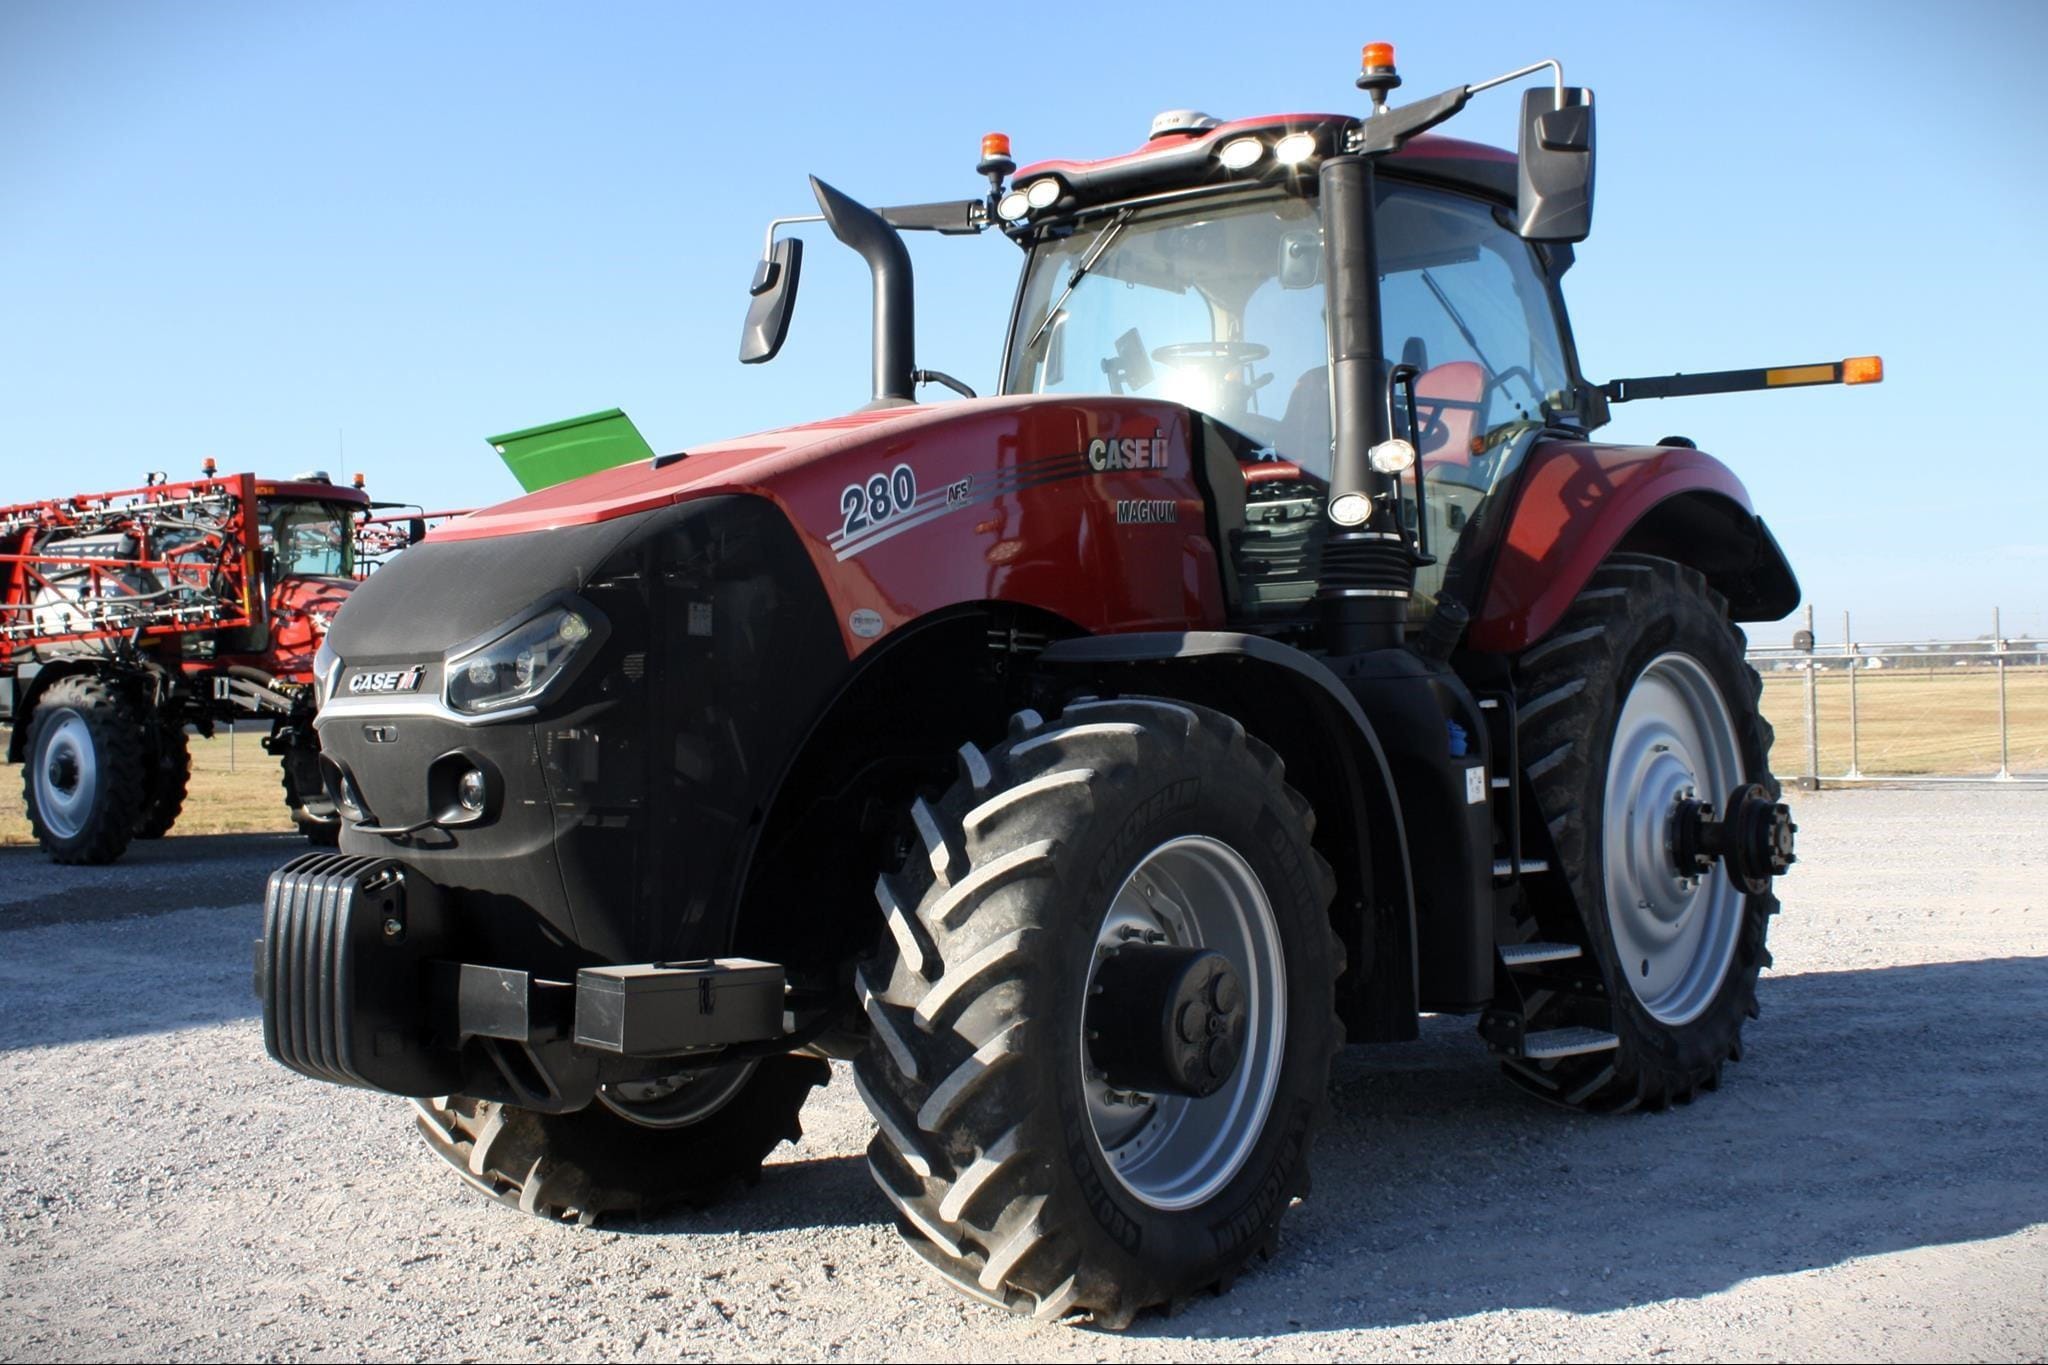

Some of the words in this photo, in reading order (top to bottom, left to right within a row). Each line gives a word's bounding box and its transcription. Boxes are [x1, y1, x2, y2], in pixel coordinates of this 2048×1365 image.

[840, 463, 917, 539] 280
[946, 479, 969, 505] AFS
[1116, 499, 1177, 523] MAGNUM
